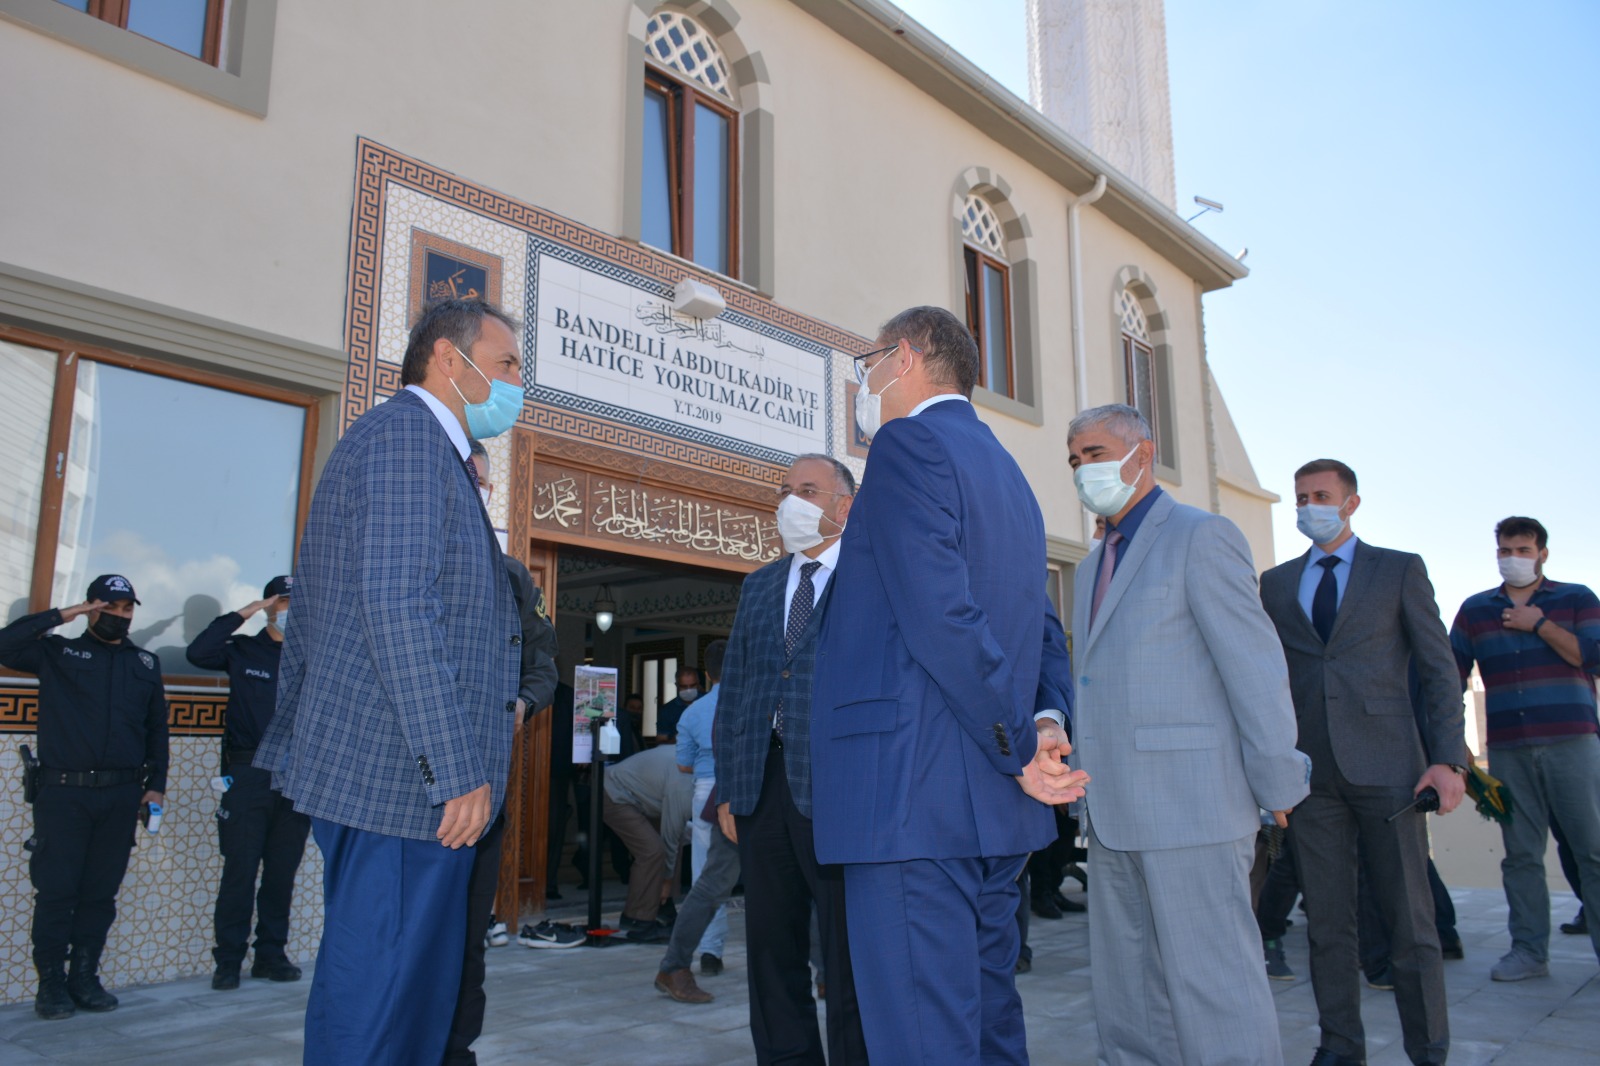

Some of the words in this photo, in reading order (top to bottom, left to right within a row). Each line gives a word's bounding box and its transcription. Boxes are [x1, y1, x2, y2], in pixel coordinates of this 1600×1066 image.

[555, 307, 666, 361] BANDELLİ
[672, 347, 793, 403] ABDULKADİR
[797, 391, 819, 411] VE
[560, 336, 645, 380] HATİCE
[654, 365, 761, 416] YORULMAZ
[764, 402, 815, 431] CAMİİ
[673, 399, 722, 425] Y.T.2019
